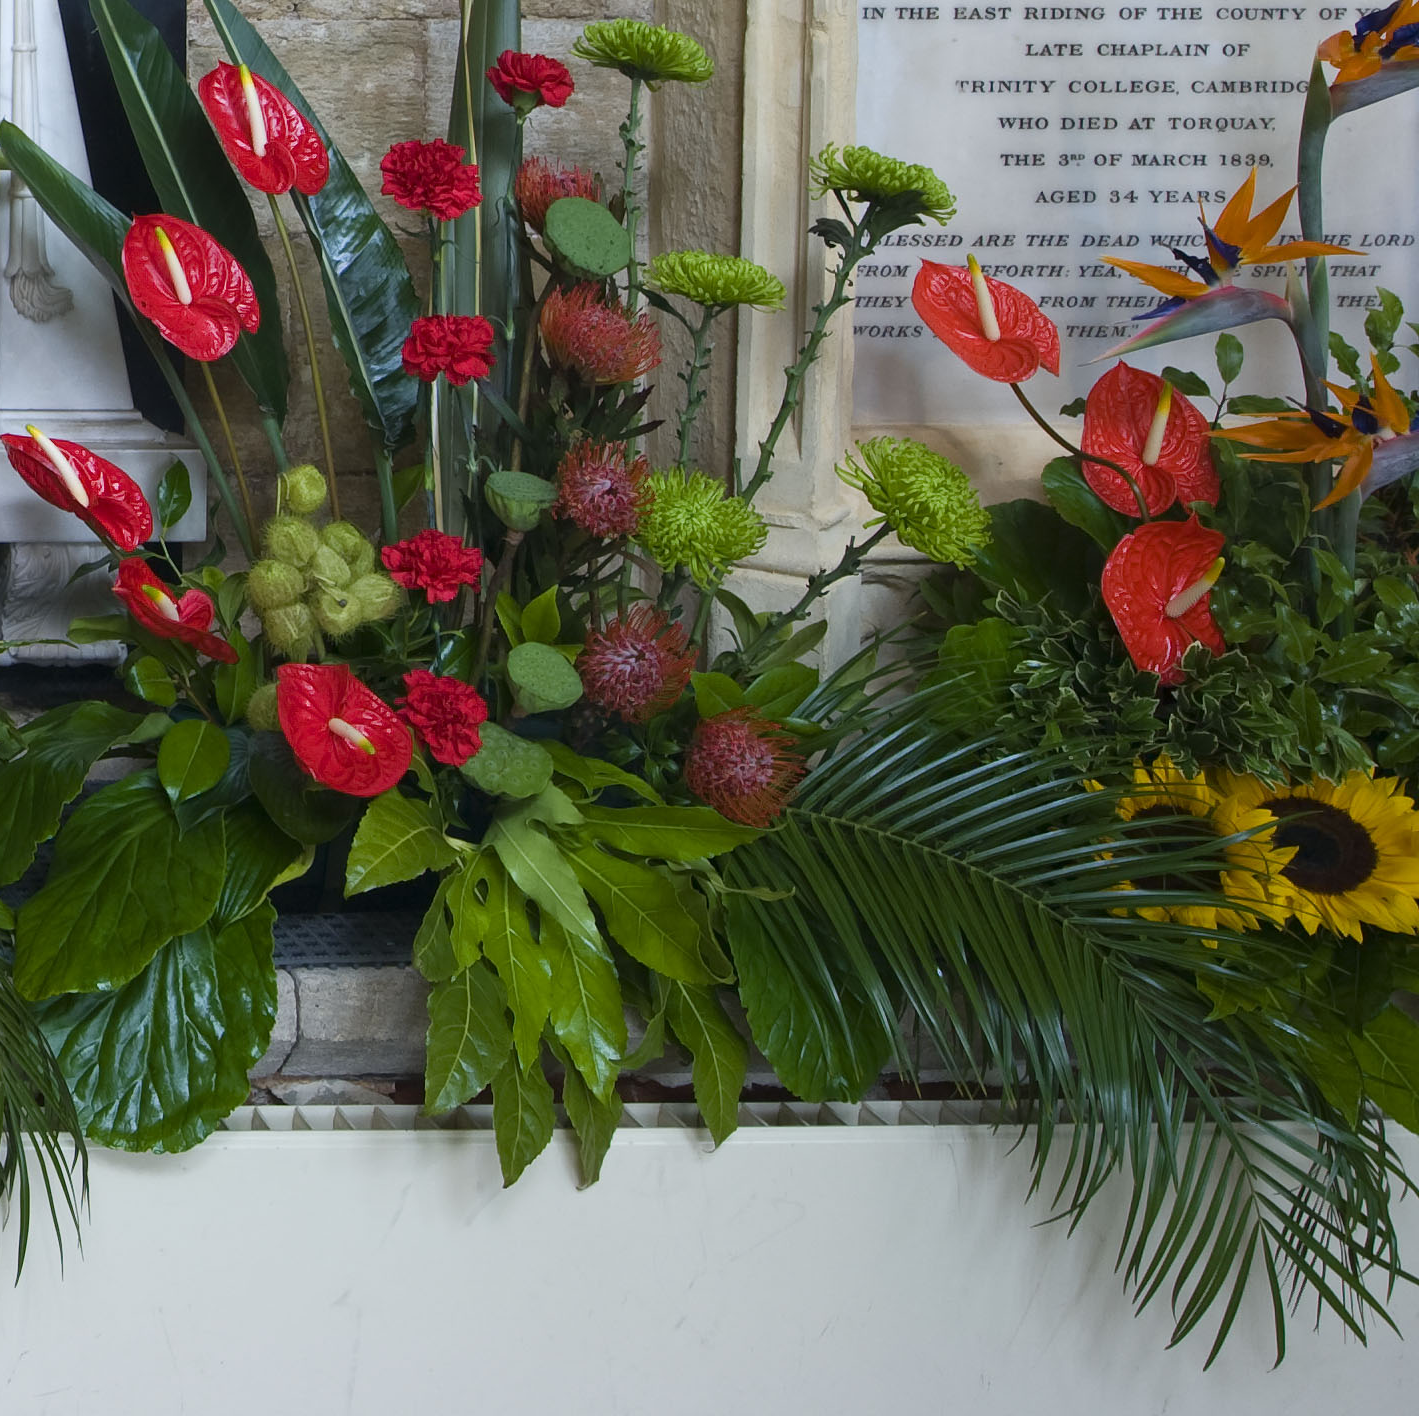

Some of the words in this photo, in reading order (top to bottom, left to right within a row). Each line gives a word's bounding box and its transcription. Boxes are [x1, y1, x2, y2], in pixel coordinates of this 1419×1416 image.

[1025, 44, 1083, 56] LATE
[1097, 44, 1210, 56] CHAPLAIN
[1222, 44, 1250, 57] OF
[998, 117, 1049, 130] WHO
[1060, 117, 1118, 130] DIED
[1128, 117, 1155, 130] AT
[1168, 117, 1275, 132] TORQUAY,
[1000, 154, 1045, 166] THE
[1094, 154, 1122, 166] OF
[1131, 154, 1207, 166] MARCH
[1035, 190, 1096, 204] AGED
[1110, 190, 1138, 203] 34
[1148, 190, 1226, 204] YEARS
